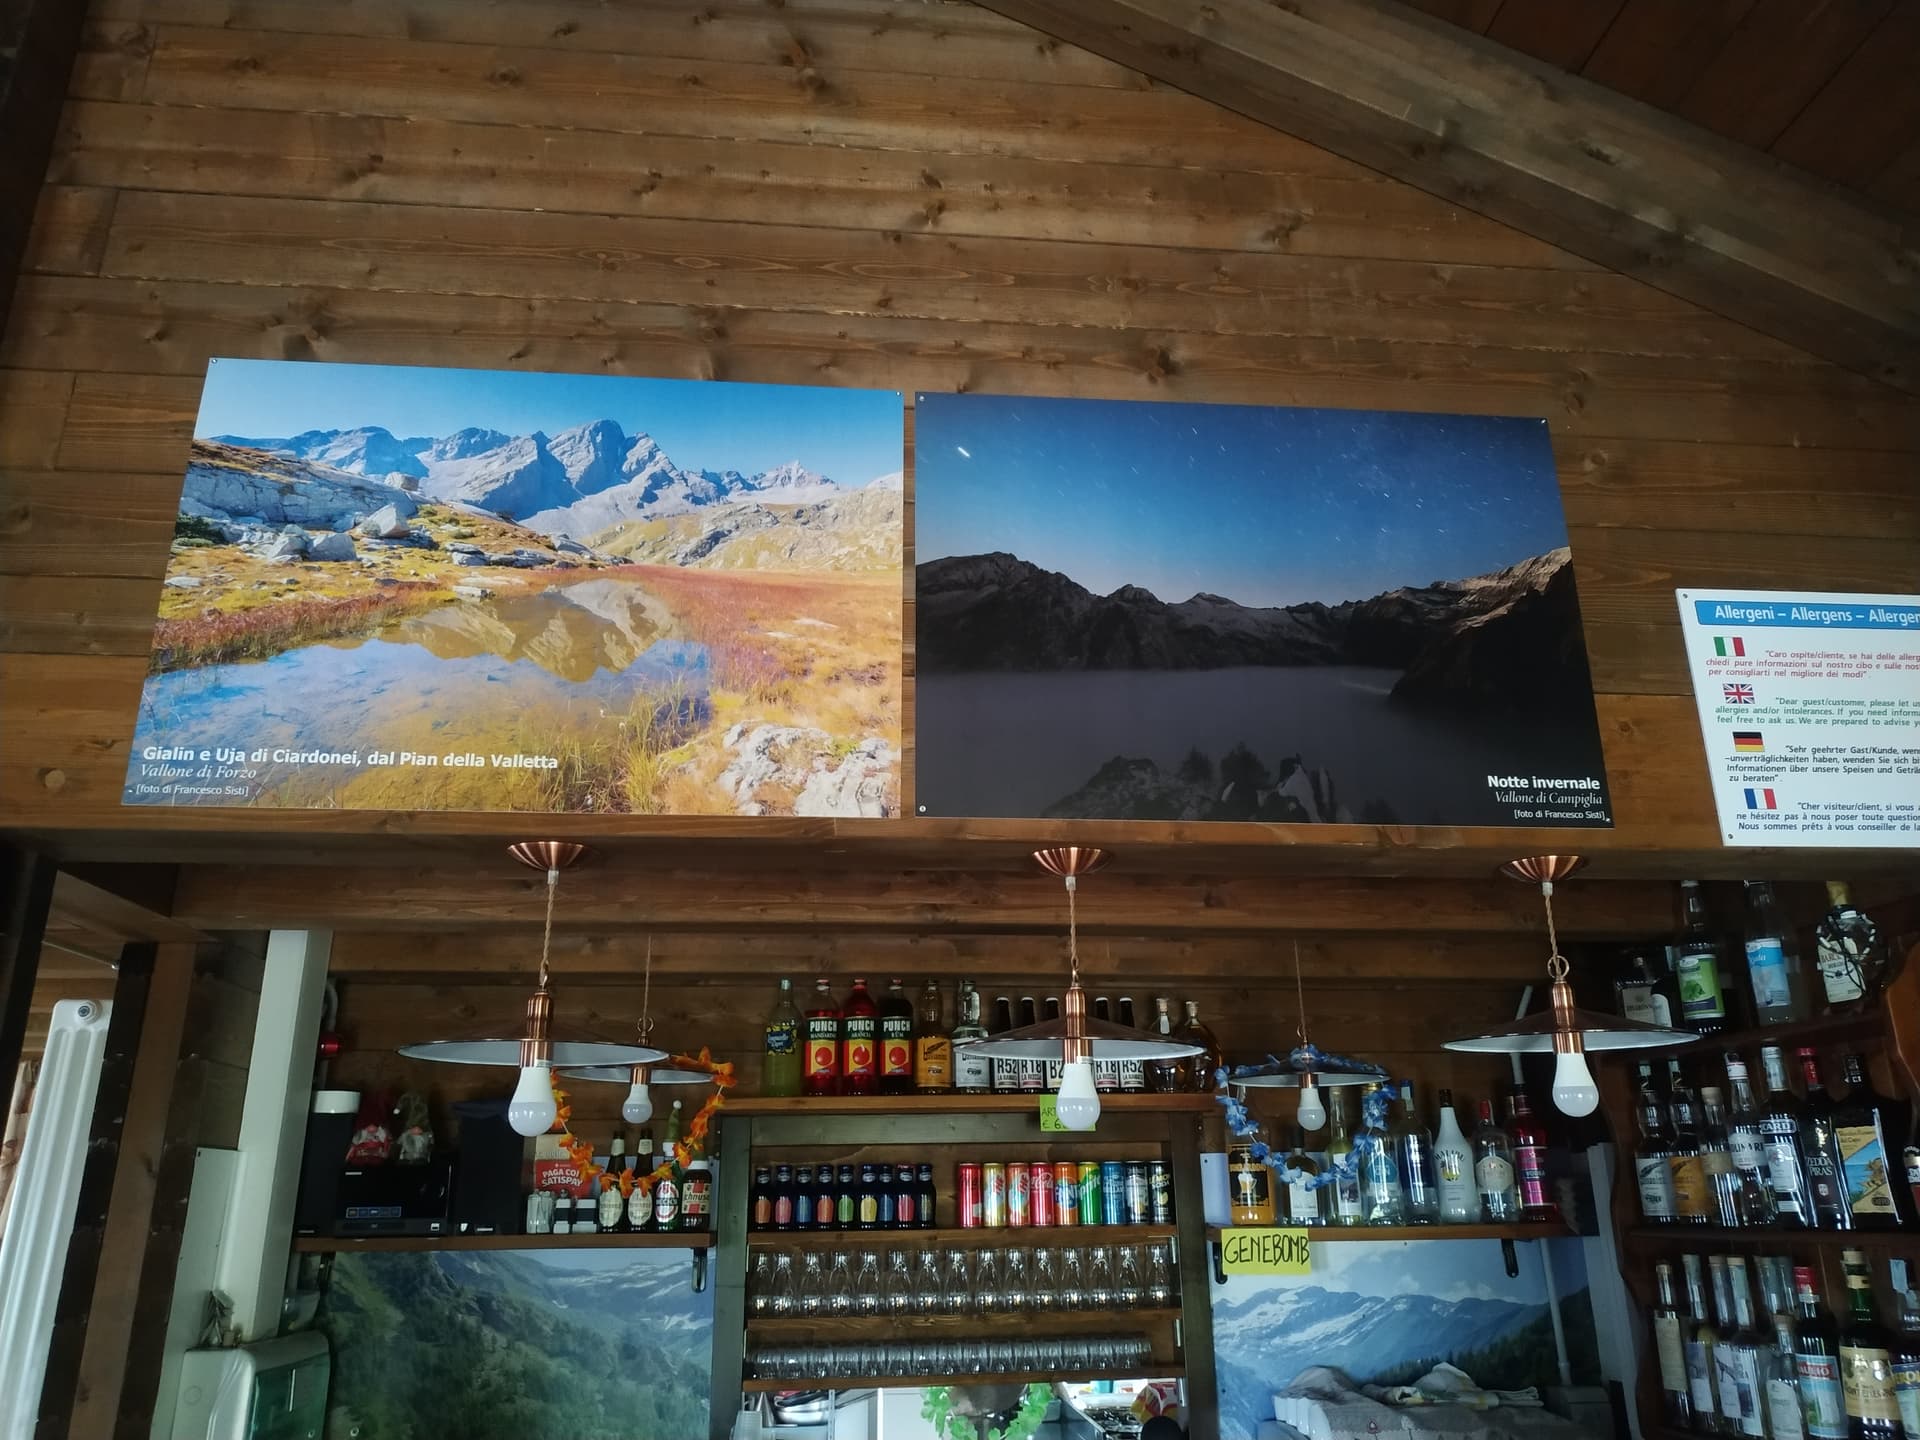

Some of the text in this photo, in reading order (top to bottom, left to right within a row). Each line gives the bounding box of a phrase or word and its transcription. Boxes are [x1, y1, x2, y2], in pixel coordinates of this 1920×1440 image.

[1714, 605, 1775, 622] Allergeni
[1791, 607, 1853, 624] Allergens
[1734, 660, 1753, 668] pure
[1756, 660, 1808, 668] informazioni
[1708, 669, 1722, 677] per
[1725, 669, 1770, 678] consigliarti
[1790, 670, 1823, 679] migliore
[1802, 698, 1866, 707] guest/customer,
[1870, 700, 1895, 708] please
[1715, 706, 1749, 715] allergies
[1752, 706, 1780, 714] and/or
[1832, 718, 1868, 727] prepared
[1811, 746, 1846, 755] geehrter
[1850, 746, 1899, 754] Gast/Kunde,
[143, 747, 558, 769] Gialin e Uja di Ciardonei, dal Pian della Valletta
[1812, 756, 1840, 764] haben,
[140, 764, 256, 779] Vallone di Forzo
[1727, 764, 1786, 773] Informationen
[1842, 766, 1874, 774] Speisen
[1487, 775, 1600, 790] Notte invernale
[136, 784, 249, 797] [foto di Francesco Sisti]
[1496, 791, 1602, 808] Vallone di Campiglia
[1824, 803, 1882, 812] visiteur/client,
[1514, 809, 1533, 819] [foto
[1545, 810, 1583, 819] Francesco
[1585, 811, 1605, 820] Sisti]
[1750, 812, 1780, 820] hésitez
[1802, 812, 1808, 820] à
[1802, 823, 1823, 832] prêts
[883, 1020, 910, 1032] PUNCH
[997, 1058, 1017, 1074] R52
[1021, 1059, 1042, 1074] R18
[1050, 1060, 1064, 1079] B2
[542, 1168, 564, 1178] PAGA
[542, 1176, 583, 1187] SATISPAY
[1224, 1234, 1310, 1266] GENEBOMB
